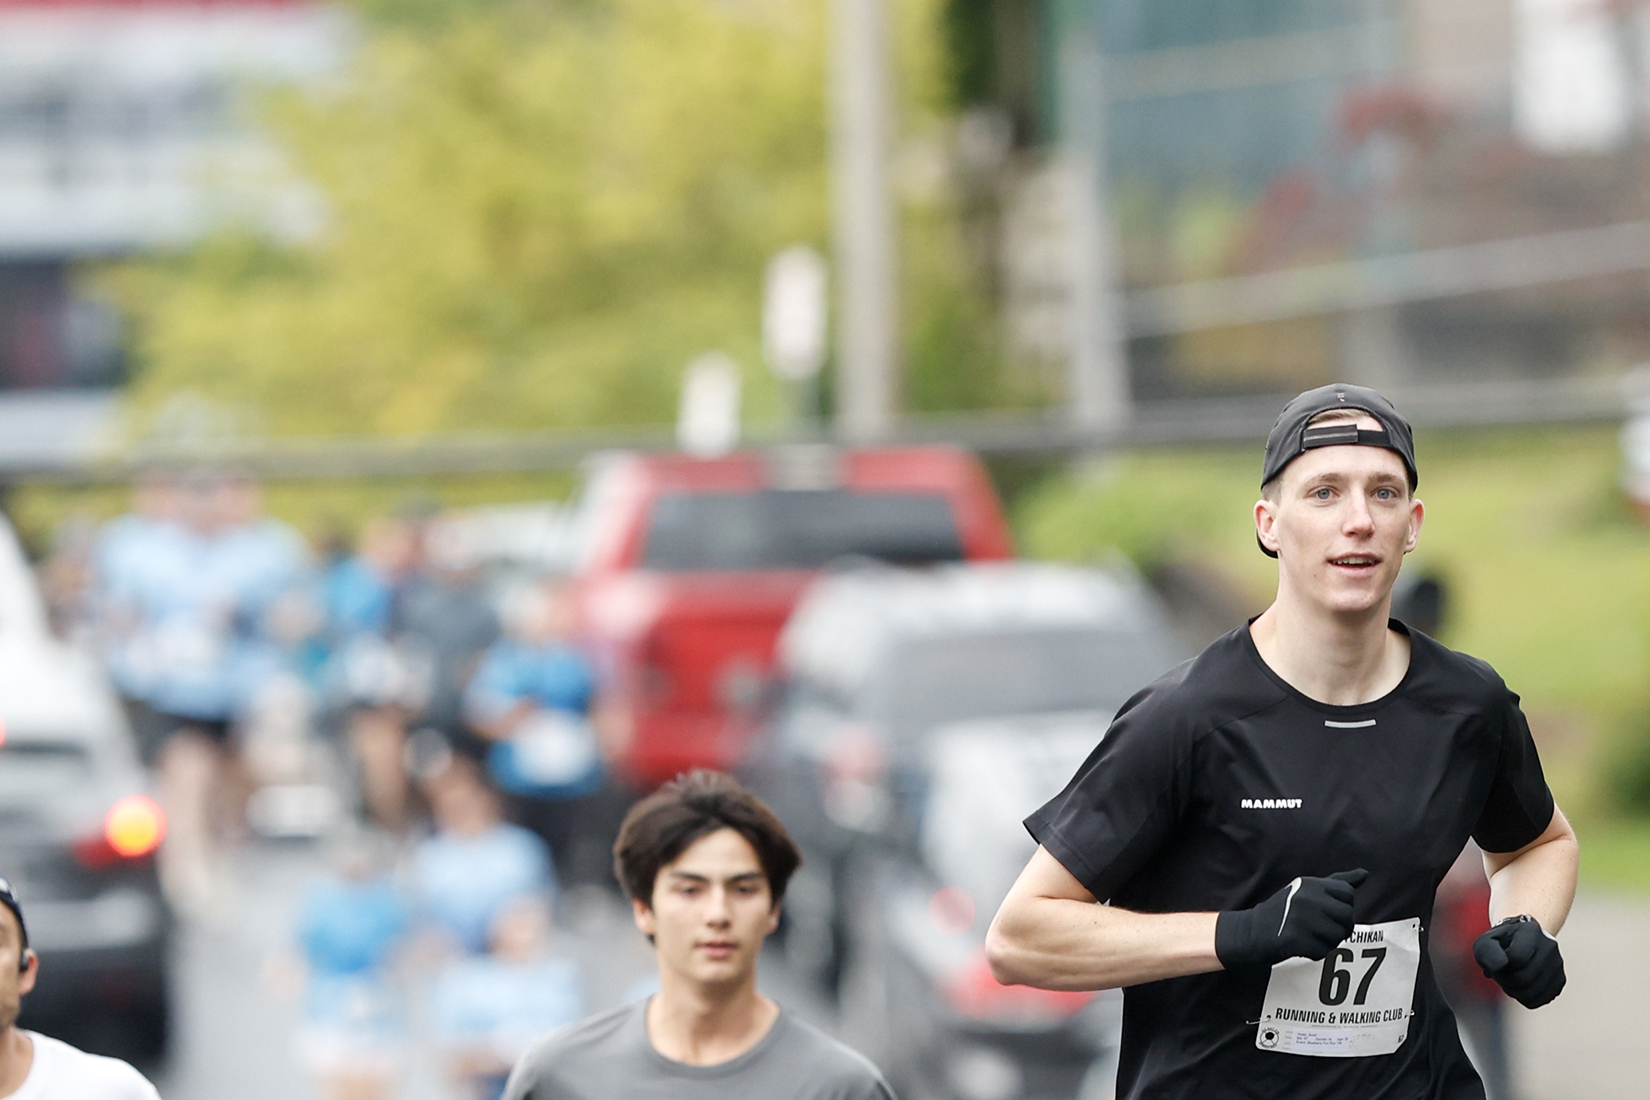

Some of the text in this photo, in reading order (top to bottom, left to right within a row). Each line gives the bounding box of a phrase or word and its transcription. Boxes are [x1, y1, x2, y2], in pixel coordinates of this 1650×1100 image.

[1241, 798, 1303, 809] MAMMUT
[1318, 947, 1387, 1006] 67
[1275, 1007, 1403, 1024] RUNNING & WALKING CLUB
